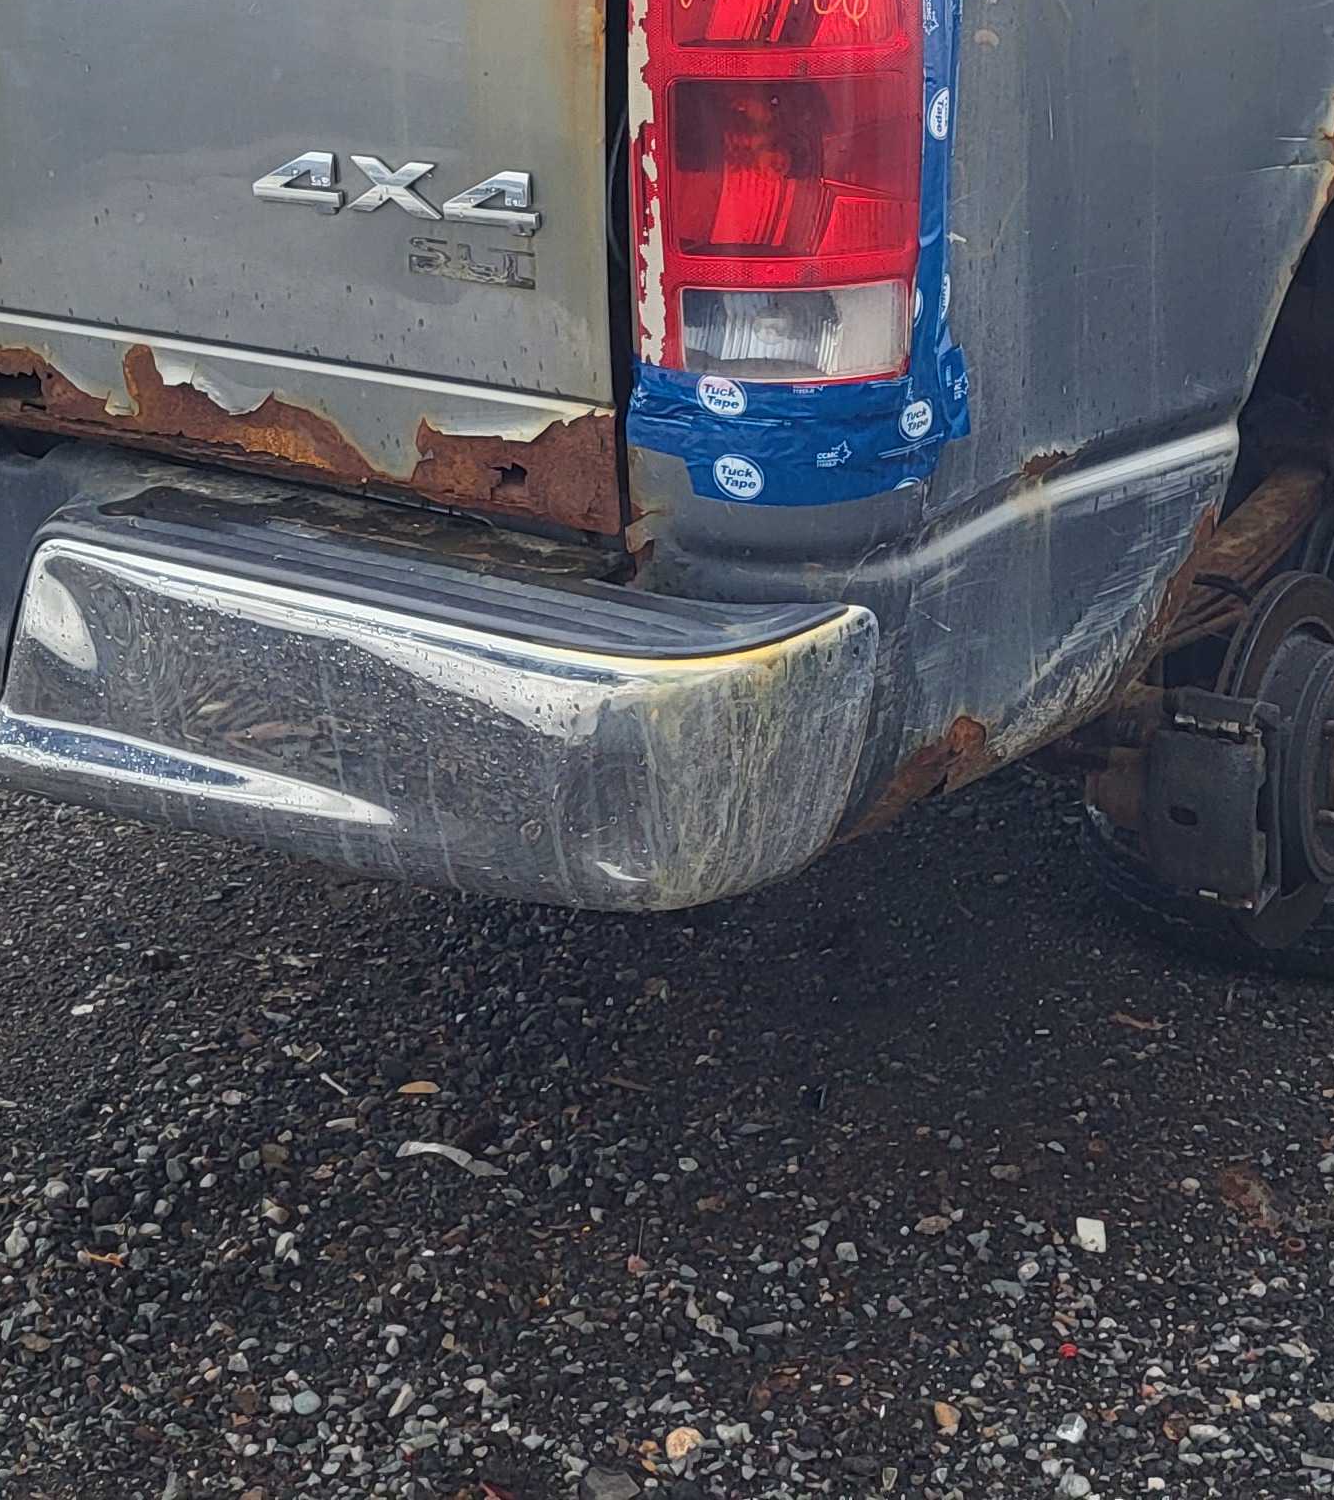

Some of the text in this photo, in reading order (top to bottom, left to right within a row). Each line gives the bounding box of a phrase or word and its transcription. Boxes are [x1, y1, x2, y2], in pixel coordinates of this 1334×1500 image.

[935, 99, 944, 133] Tape
[704, 383, 737, 398] Tuck
[707, 395, 740, 410] Tape
[906, 406, 928, 422] Tuck
[721, 464, 754, 478] Tuck
[724, 476, 757, 490] Tape
